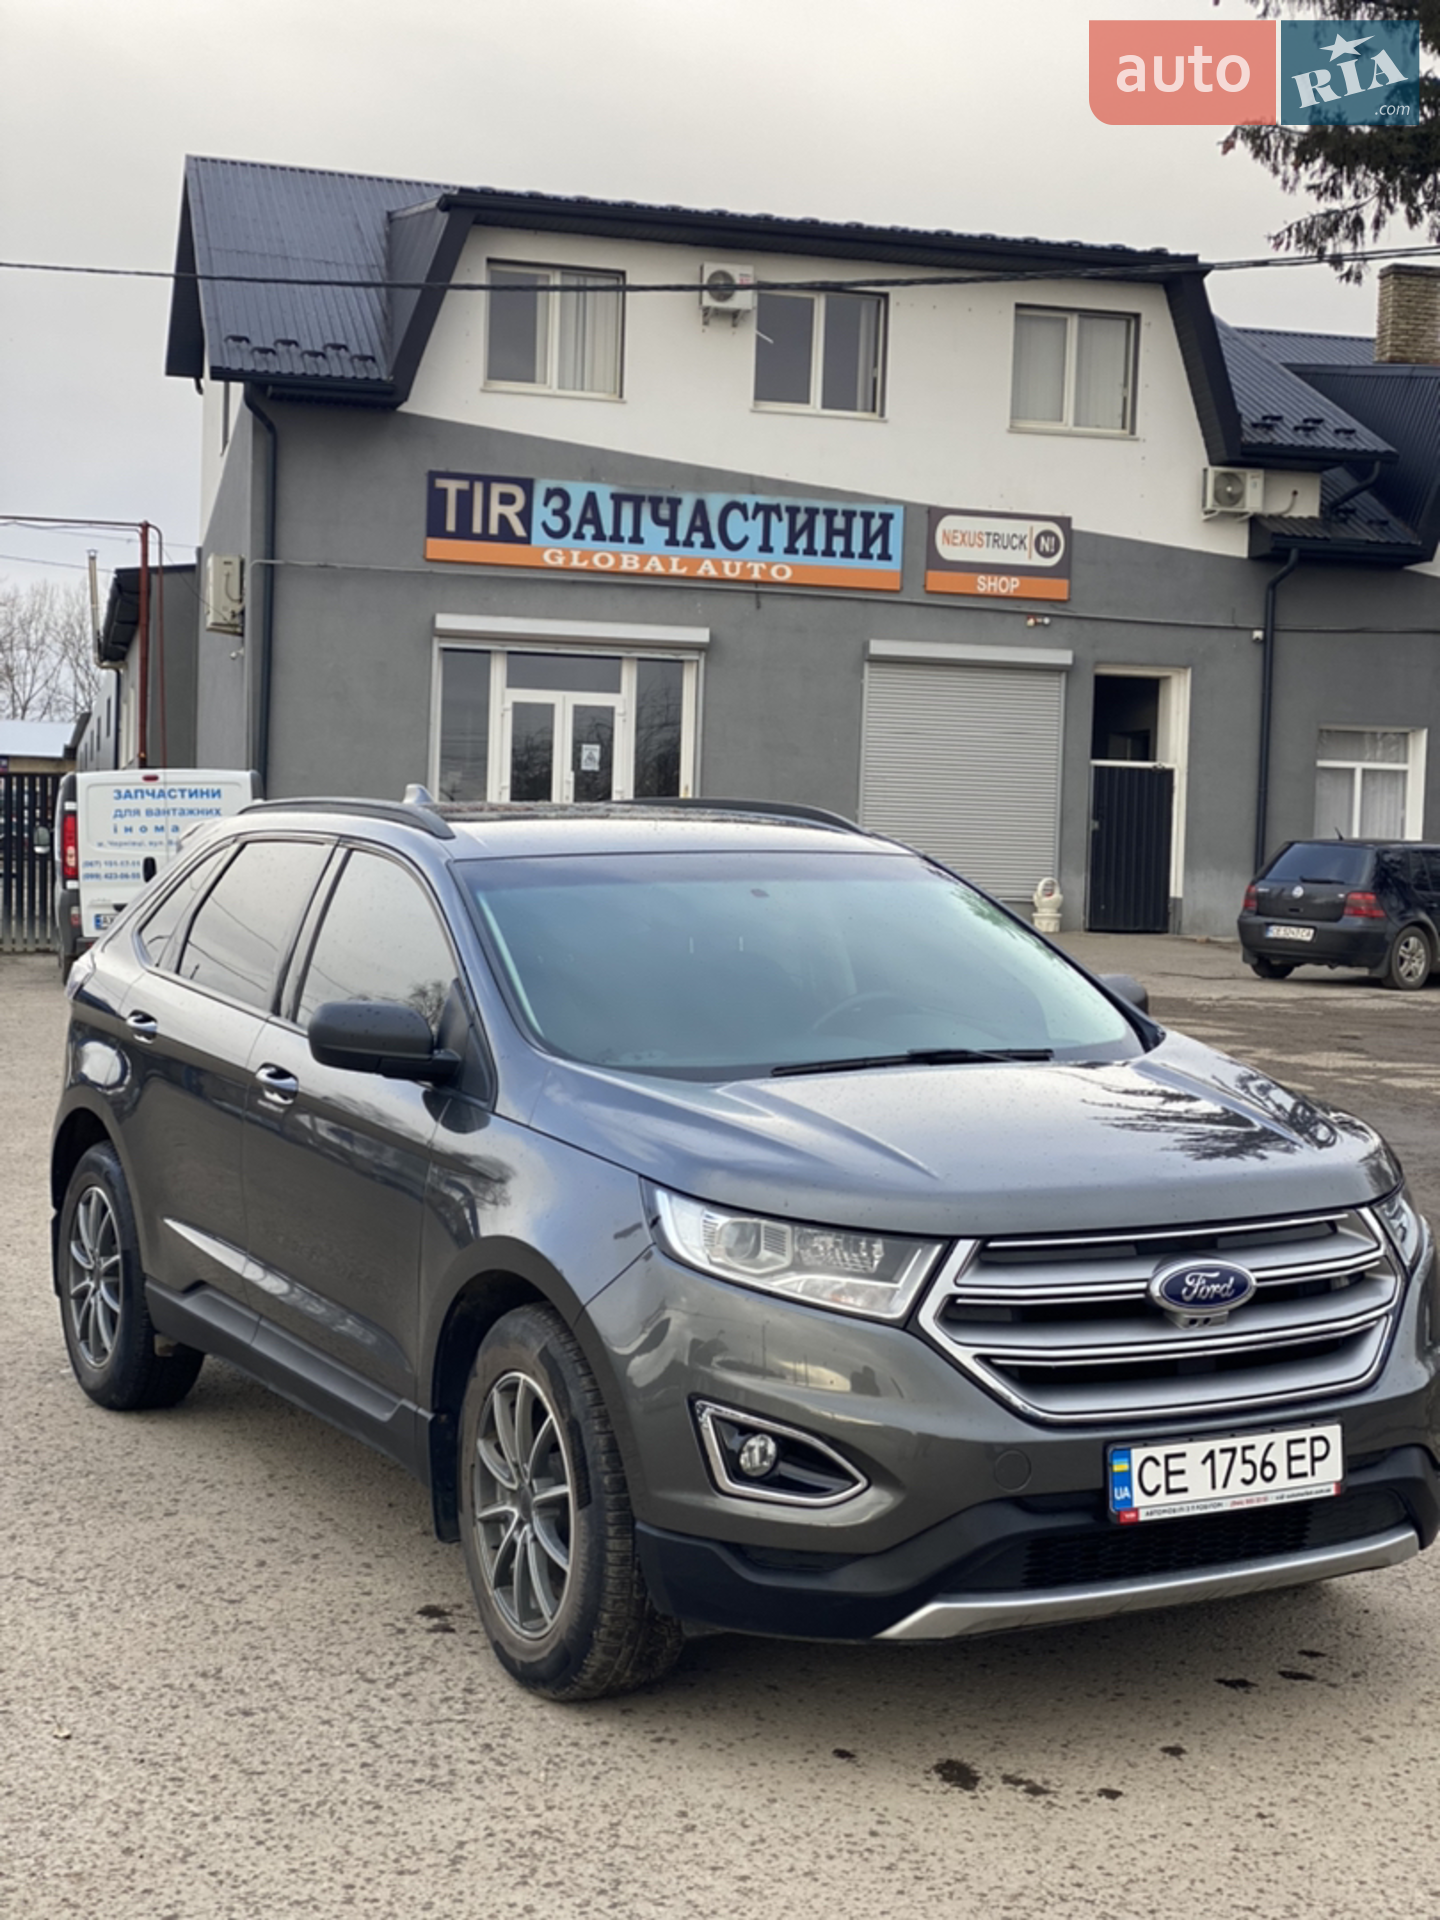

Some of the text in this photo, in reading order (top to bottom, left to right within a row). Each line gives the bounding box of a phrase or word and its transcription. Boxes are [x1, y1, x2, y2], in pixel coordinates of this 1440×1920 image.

[434, 478, 527, 538] TIR
[541, 487, 895, 562] ЗАПЧАСТИНИ
[941, 529, 1028, 551] NEXUSTRUCK
[542, 548, 794, 582] GLOBAL AUTO
[976, 575, 1020, 594] SHOP
[113, 788, 222, 800] ЗАПЧАСТИНИ
[113, 807, 222, 819] для вантажних
[1182, 1272, 1234, 1302] Ford
[1137, 1435, 1331, 1497] CE 1756 EP
[1114, 1486, 1131, 1500] UA
